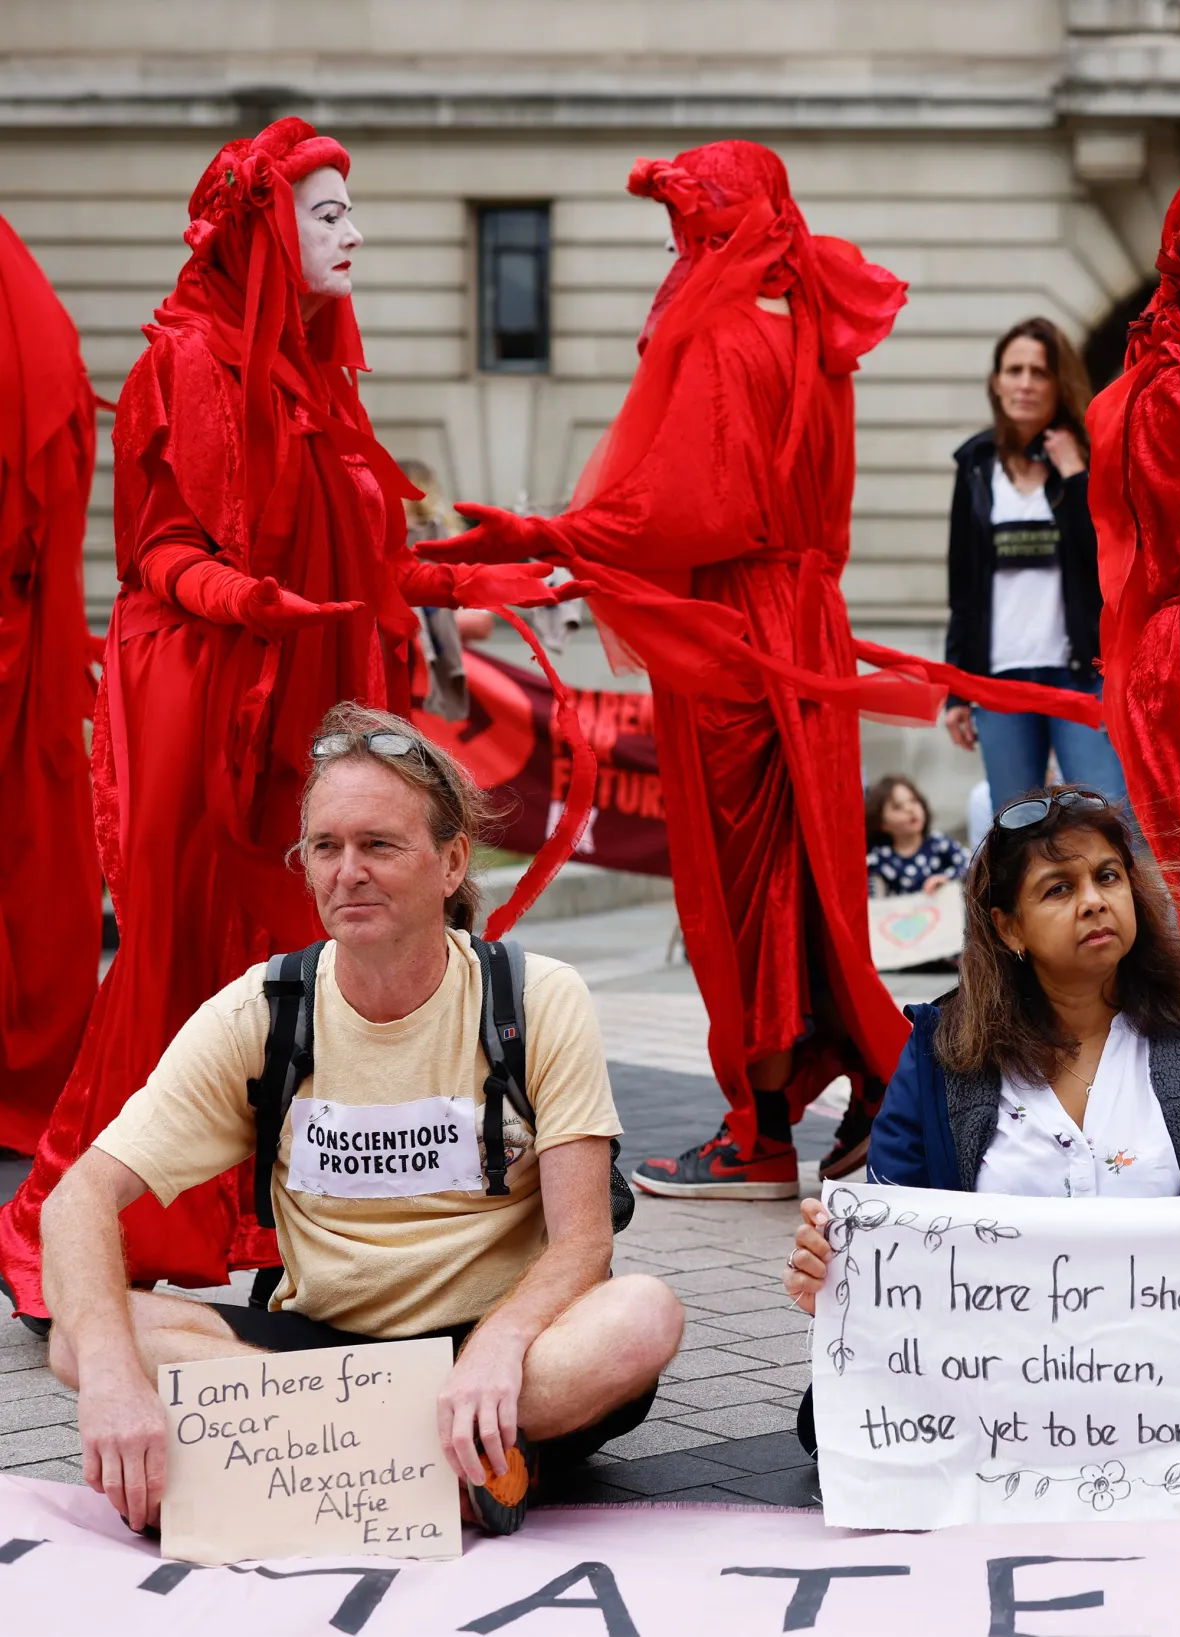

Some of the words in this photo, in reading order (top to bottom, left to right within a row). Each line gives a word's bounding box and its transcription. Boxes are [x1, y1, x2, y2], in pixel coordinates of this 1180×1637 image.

[306, 1124, 459, 1152] CONSCIENTIOUS
[320, 1150, 440, 1175] PROTECTOR
[874, 1242, 922, 1311] I'm
[949, 1246, 1031, 1312] here
[1047, 1254, 1104, 1324] for
[169, 1369, 183, 1406] I
[198, 1382, 249, 1407] am
[261, 1362, 324, 1397] here
[336, 1353, 392, 1403] for:
[888, 1338, 924, 1377] all
[941, 1354, 1003, 1381] our
[1022, 1344, 1163, 1387] children,
[177, 1412, 280, 1445] Oscar
[224, 1422, 361, 1470] Arabella
[860, 1406, 956, 1450] those
[978, 1412, 1029, 1459] yet
[1042, 1410, 1077, 1447] to
[1086, 1414, 1118, 1446] be
[268, 1459, 435, 1499] Alexander
[315, 1488, 391, 1525] Alfie
[363, 1518, 443, 1545] Ezra
